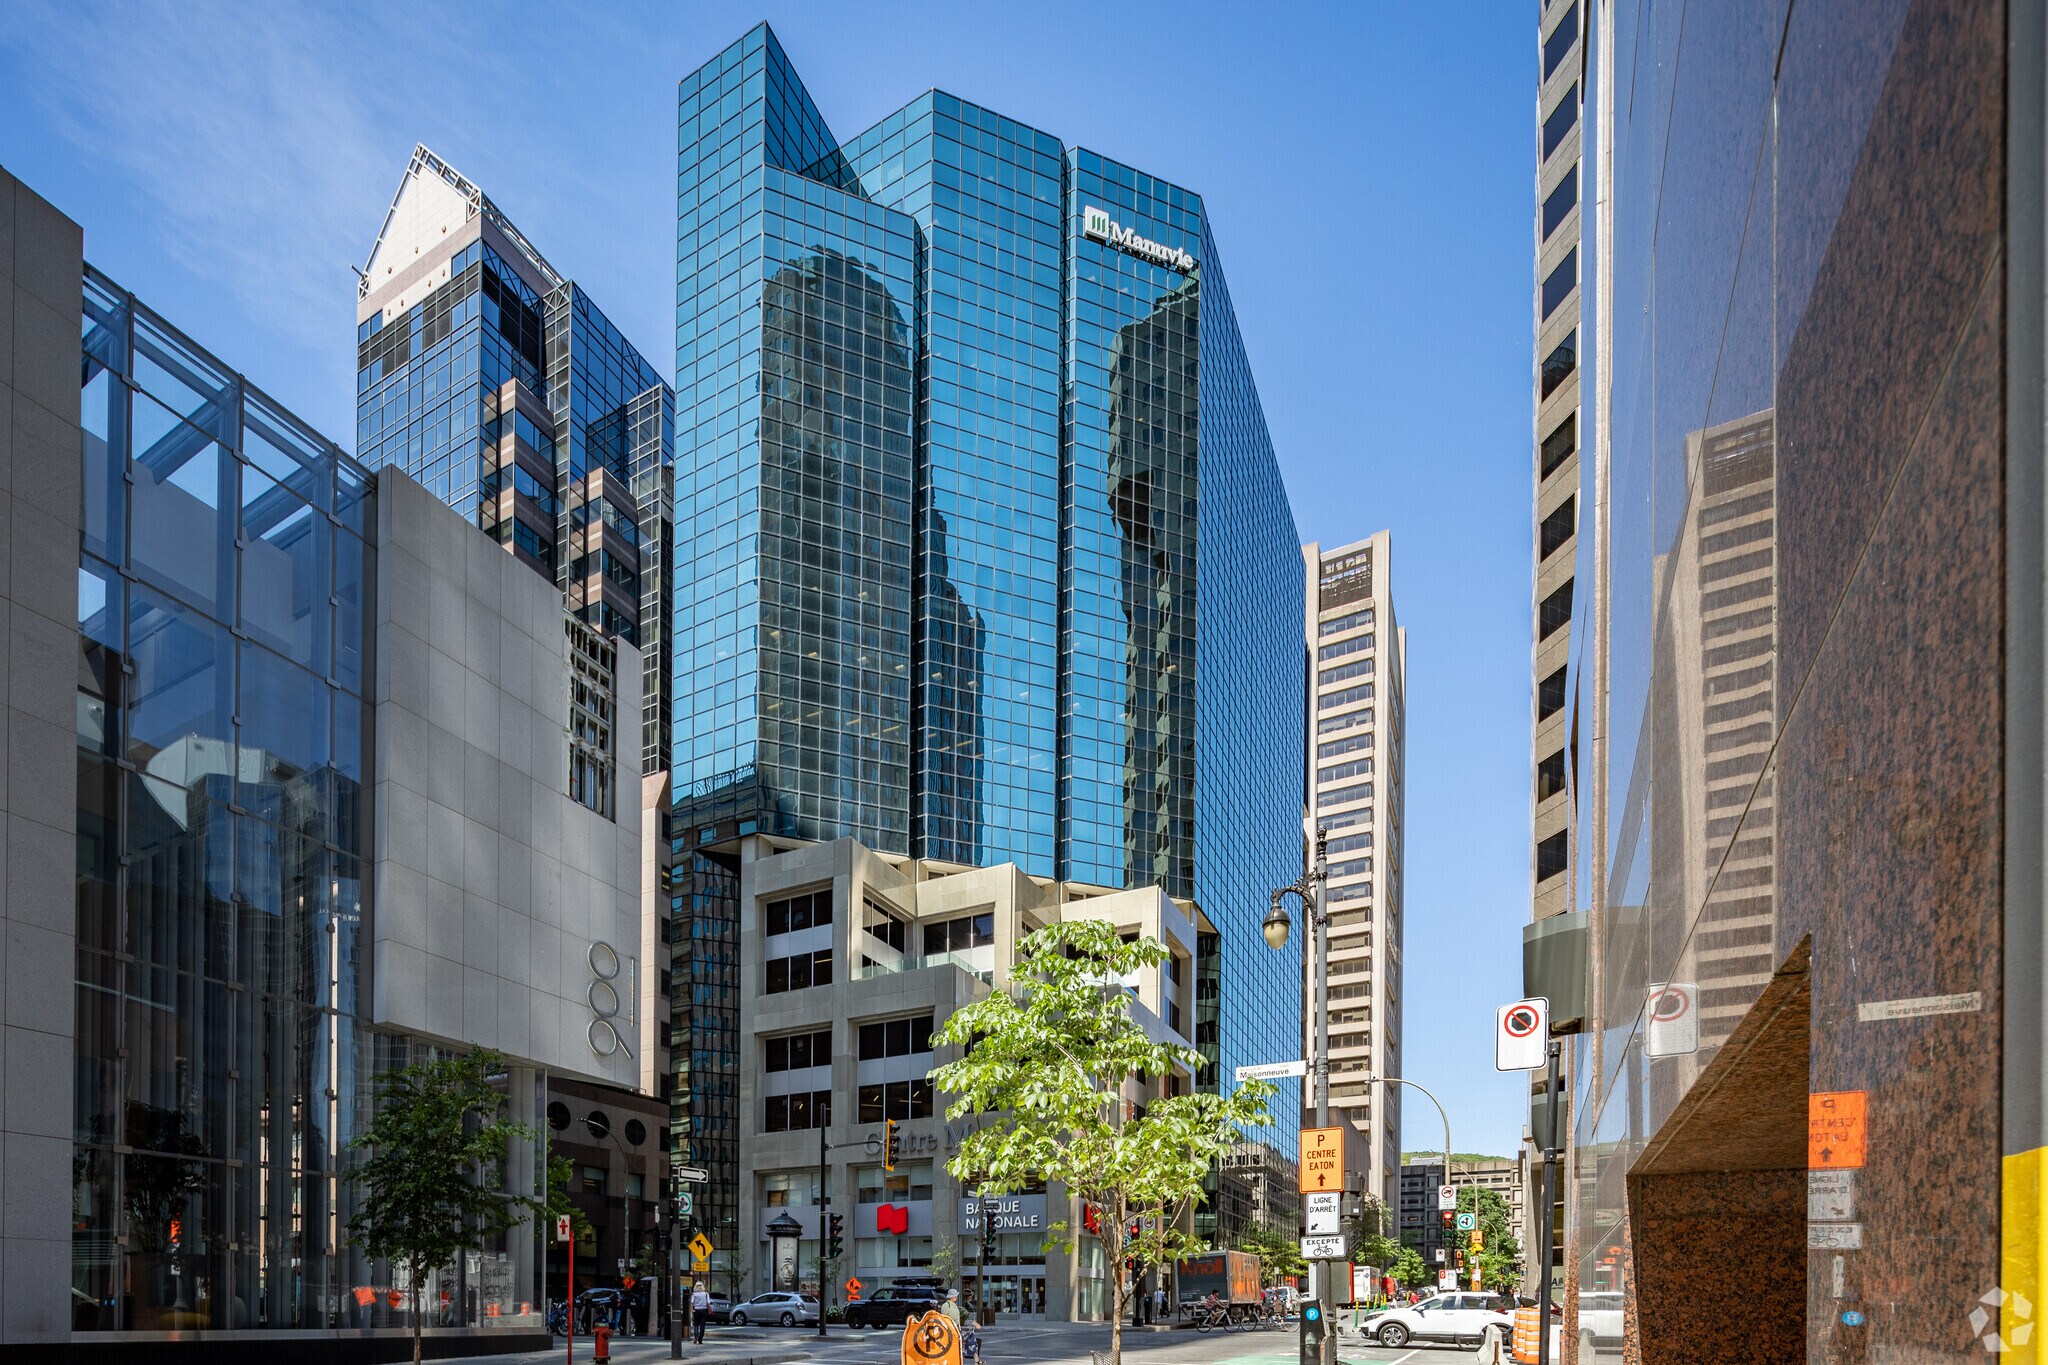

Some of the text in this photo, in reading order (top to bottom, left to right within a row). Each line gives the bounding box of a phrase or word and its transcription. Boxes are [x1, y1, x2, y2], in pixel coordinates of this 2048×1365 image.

[1110, 221, 1193, 270] Manuvie
[1240, 1068, 1290, 1079] Maisonneuve
[1317, 1134, 1325, 1147] P
[1306, 1149, 1336, 1159] CENTRE
[1309, 1161, 1335, 1171] EATON
[1313, 1196, 1332, 1204] LIGNE
[966, 1200, 1020, 1215] BAQUE
[1309, 1204, 1337, 1213] D'ARRÊT
[966, 1215, 1039, 1229] NATONALE
[1181, 1257, 1223, 1278] Knoll
